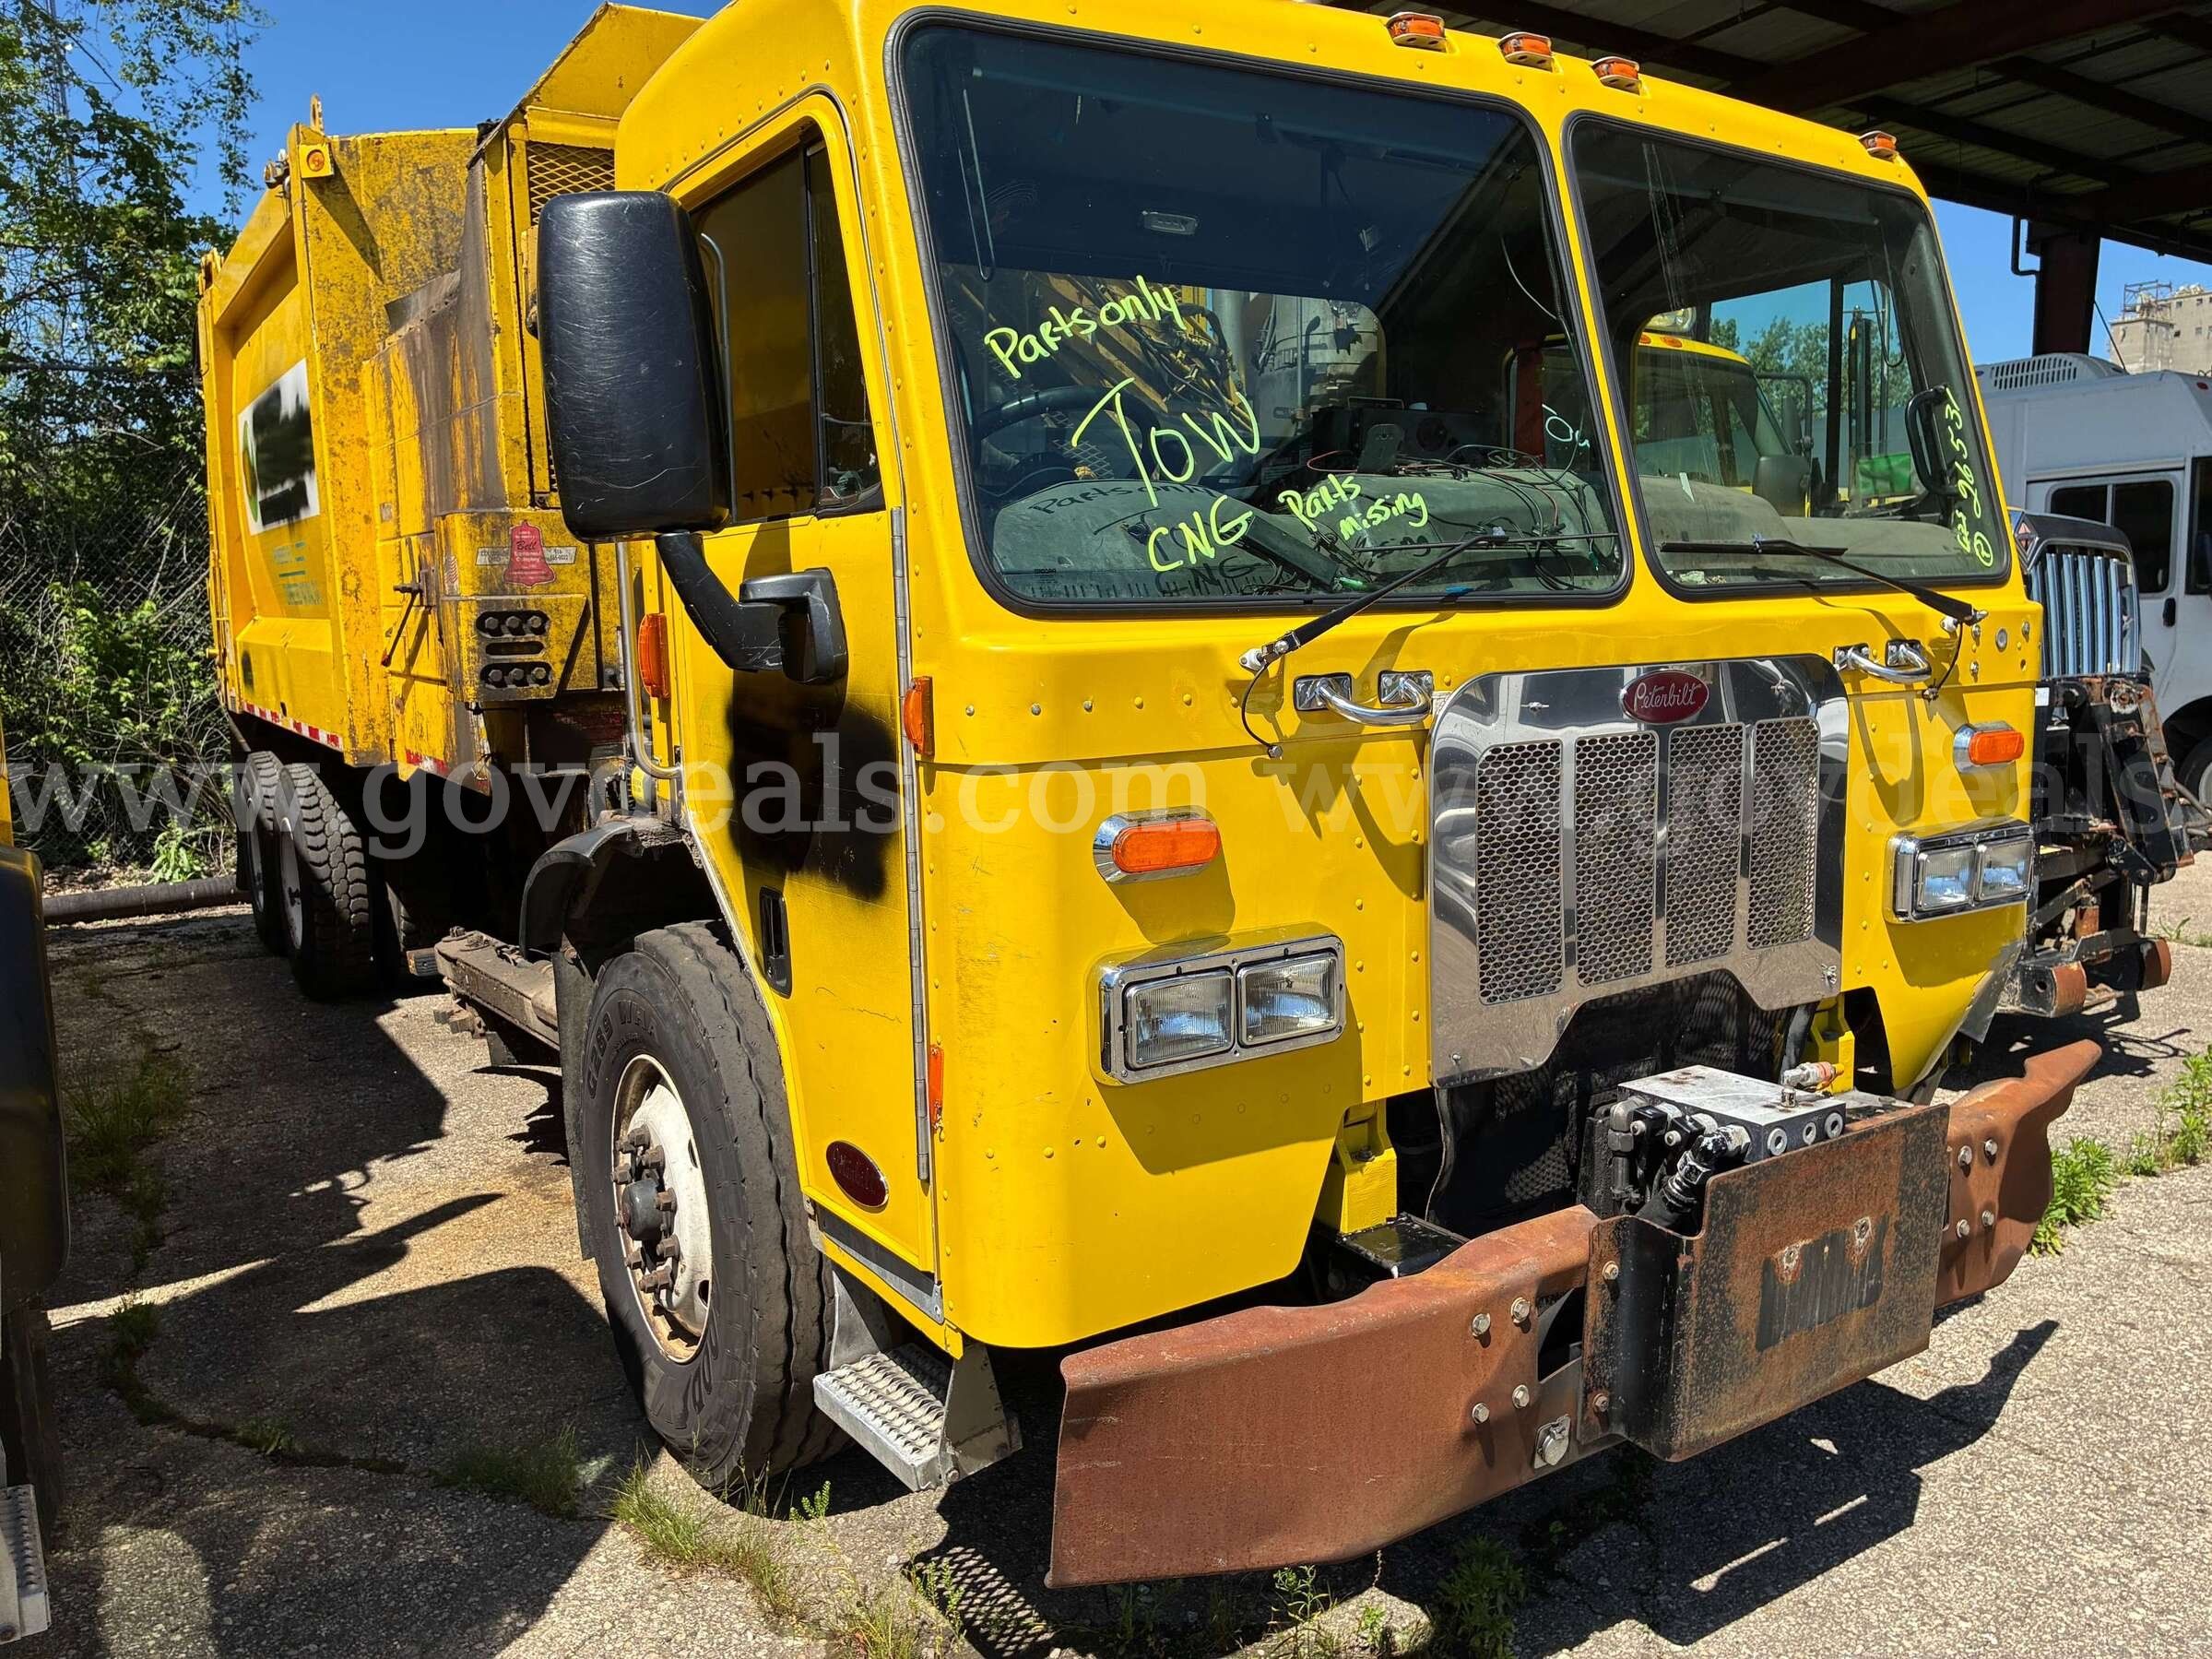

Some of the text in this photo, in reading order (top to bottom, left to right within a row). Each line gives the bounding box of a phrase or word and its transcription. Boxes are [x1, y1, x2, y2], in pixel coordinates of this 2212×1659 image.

[983, 275, 1188, 379] Parts only
[1071, 376, 1260, 507] TOW
[1277, 473, 1362, 532] Parts
[1338, 492, 1428, 541] missing
[515, 540, 538, 551] Bell
[1146, 494, 1254, 573] CNG
[1633, 681, 1702, 713] Peterbilt
